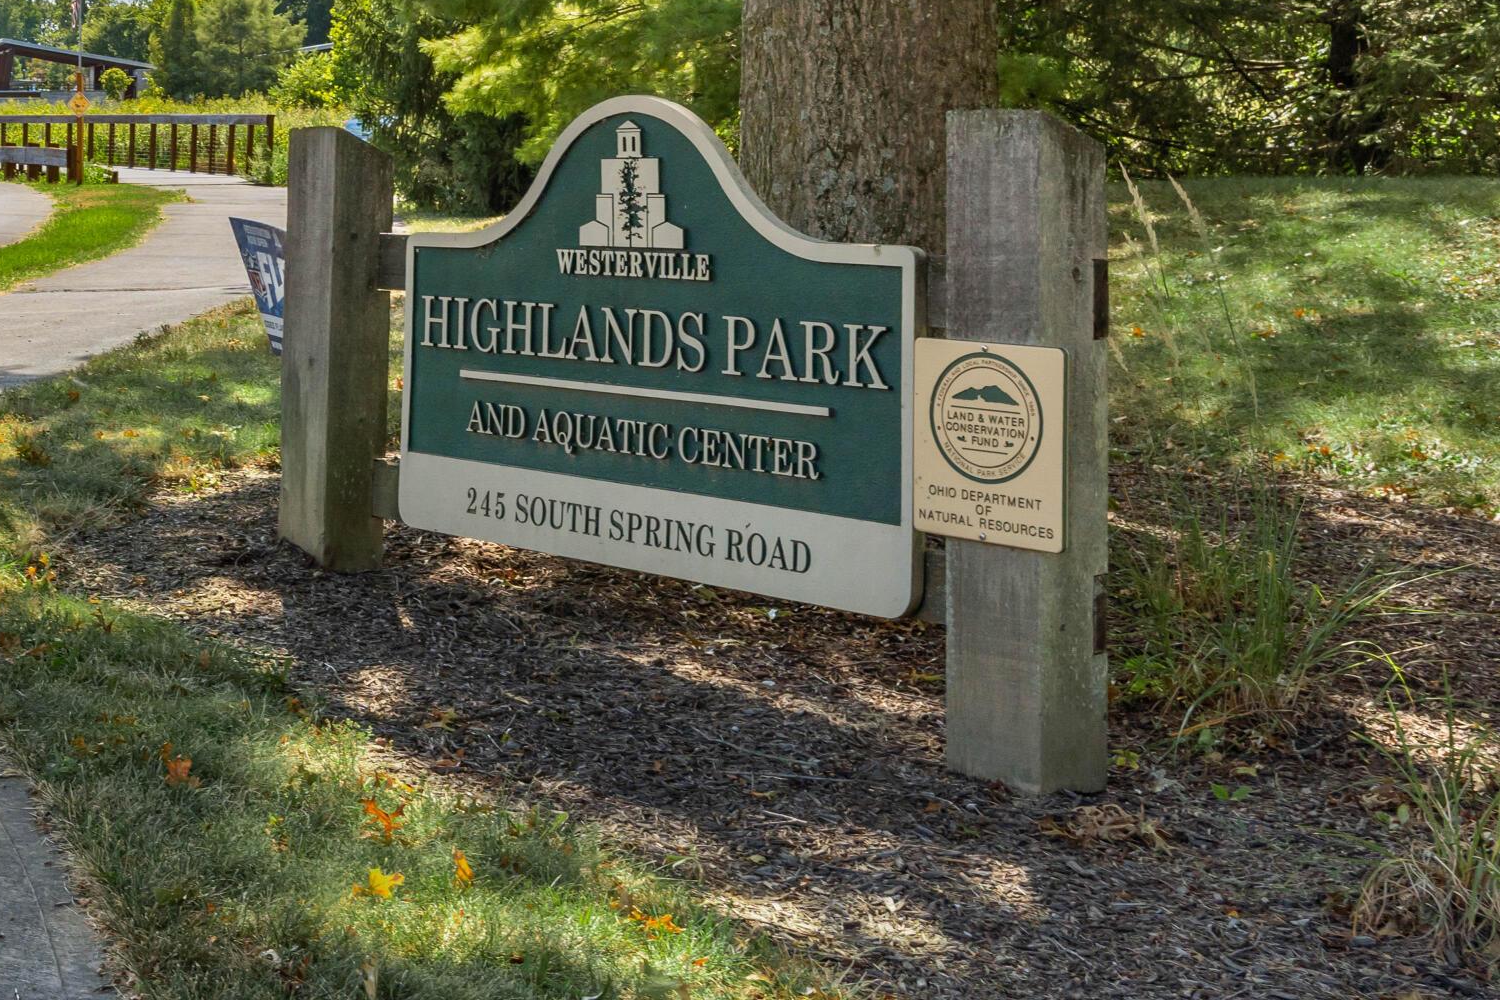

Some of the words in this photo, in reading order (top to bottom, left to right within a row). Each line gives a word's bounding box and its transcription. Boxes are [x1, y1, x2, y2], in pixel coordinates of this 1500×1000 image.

[556, 249, 710, 281] WESTERVILLE
[421, 295, 706, 373] HIGHLANDS
[722, 315, 889, 390] PARK
[962, 360, 980, 369] LOCAL
[945, 422, 1025, 440] CONSERVATION
[947, 410, 974, 422] LAND
[977, 413, 985, 423] &
[988, 414, 1025, 427] WATER
[466, 401, 526, 438] AND
[532, 409, 669, 459] AQUATIC
[678, 426, 820, 480] CENTER
[971, 435, 999, 448] FUND
[944, 441, 974, 474] NATIONAL
[977, 467, 997, 477] PARK
[999, 453, 1026, 476] SERVICE
[928, 484, 957, 498] OHIO
[961, 489, 1042, 511] DEPARTMENT
[975, 504, 992, 516] OF
[466, 487, 506, 520] 245
[515, 494, 602, 537] SOUTH
[609, 509, 716, 558] SPRING
[725, 528, 812, 574] ROAD
[918, 508, 973, 527] NATURAL
[979, 517, 1054, 539] RESOURCES
